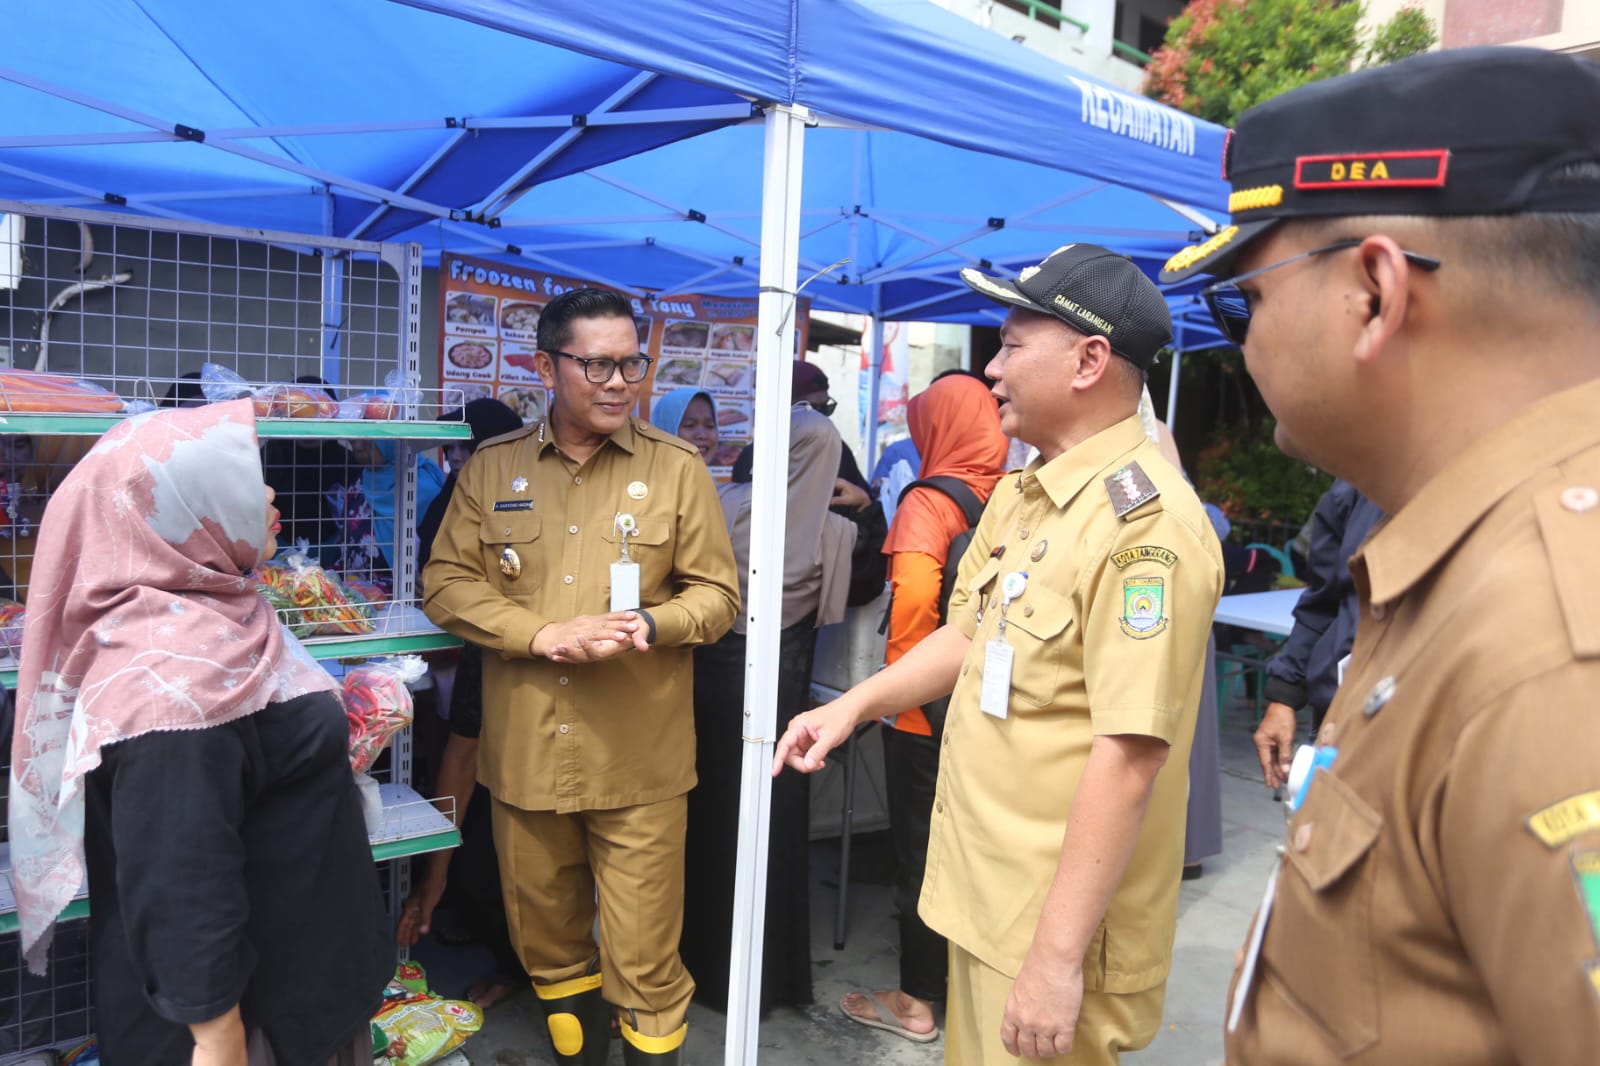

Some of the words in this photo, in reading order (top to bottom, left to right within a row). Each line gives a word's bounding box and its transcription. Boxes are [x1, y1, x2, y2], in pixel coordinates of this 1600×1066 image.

[1330, 160, 1391, 181] DEA
[450, 259, 537, 293] Froozen
[1054, 294, 1080, 312] CAMAT
[1076, 307, 1114, 335] LARANGAN
[1115, 550, 1136, 564] KOTA
[1135, 547, 1175, 563] TANGERANG
